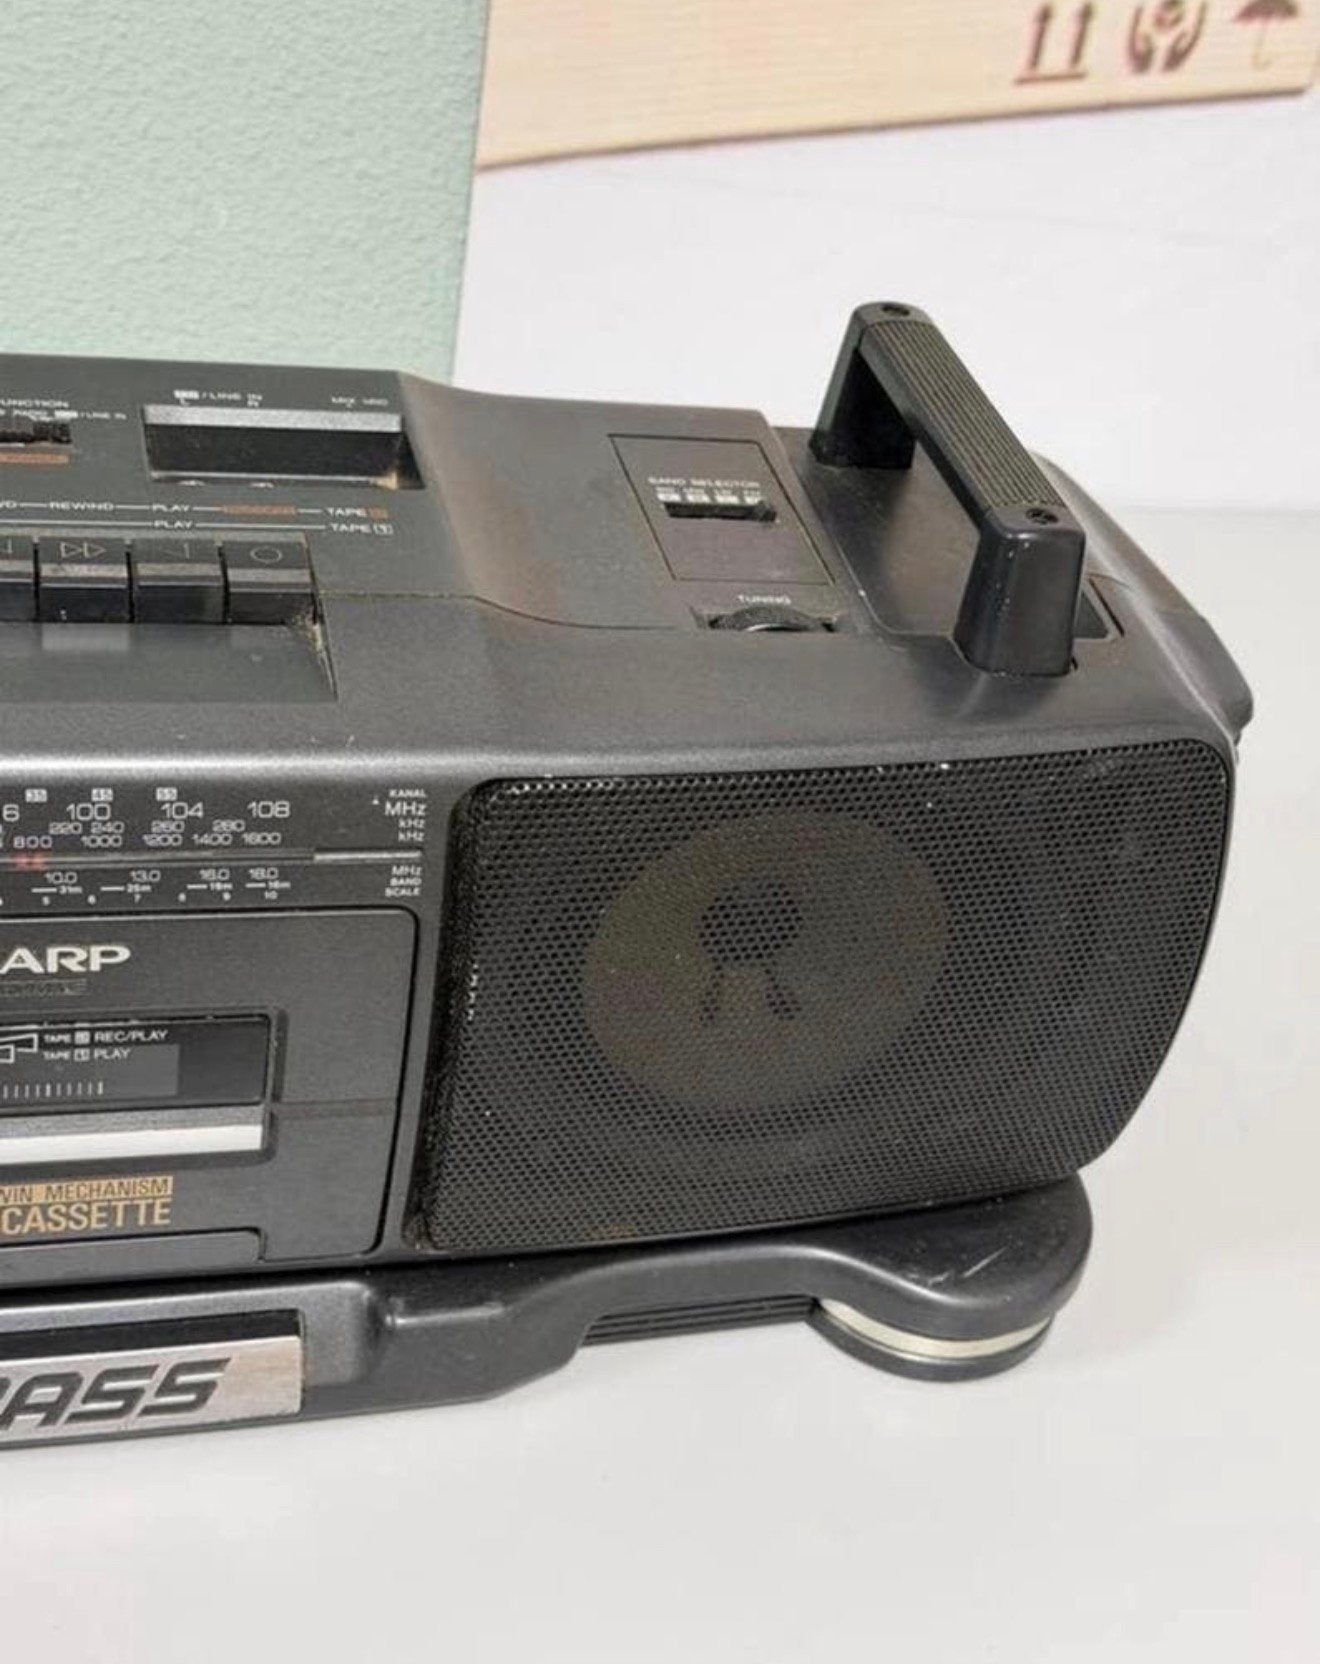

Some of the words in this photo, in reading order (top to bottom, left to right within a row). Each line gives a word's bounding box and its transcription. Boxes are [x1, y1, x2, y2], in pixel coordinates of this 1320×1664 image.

[50, 502, 115, 511] REWIND
[152, 504, 191, 512] PLAY
[326, 507, 368, 516] TAPE
[154, 520, 193, 529] PLAY
[330, 523, 371, 533] TAPE
[389, 789, 427, 798] KANAL
[3, 804, 20, 822] 6
[66, 803, 111, 821] 100
[161, 802, 204, 820] 104
[247, 800, 291, 818] 108
[385, 801, 427, 816] MHz
[49, 822, 83, 835] 220
[90, 821, 125, 834] 240
[398, 819, 425, 828] kHz
[13, 836, 53, 849] 800
[81, 835, 123, 848] 1000
[142, 834, 183, 846] 1200
[398, 832, 425, 841] kHz
[45, 871, 78, 885] 10.0
[392, 865, 422, 876] MHz
[390, 877, 422, 887] BAND
[385, 887, 420, 897] SCALE
[0, 945, 131, 974] ARP
[44, 1034, 71, 1043] TAPE
[94, 1029, 168, 1042] REC/PLAY
[43, 1051, 70, 1060] TAPE
[94, 1048, 131, 1059] PLAY
[45, 1178, 171, 1200] MECHANISM
[1, 1199, 172, 1236] CASSETTE
[0, 1357, 231, 1430] ASS
